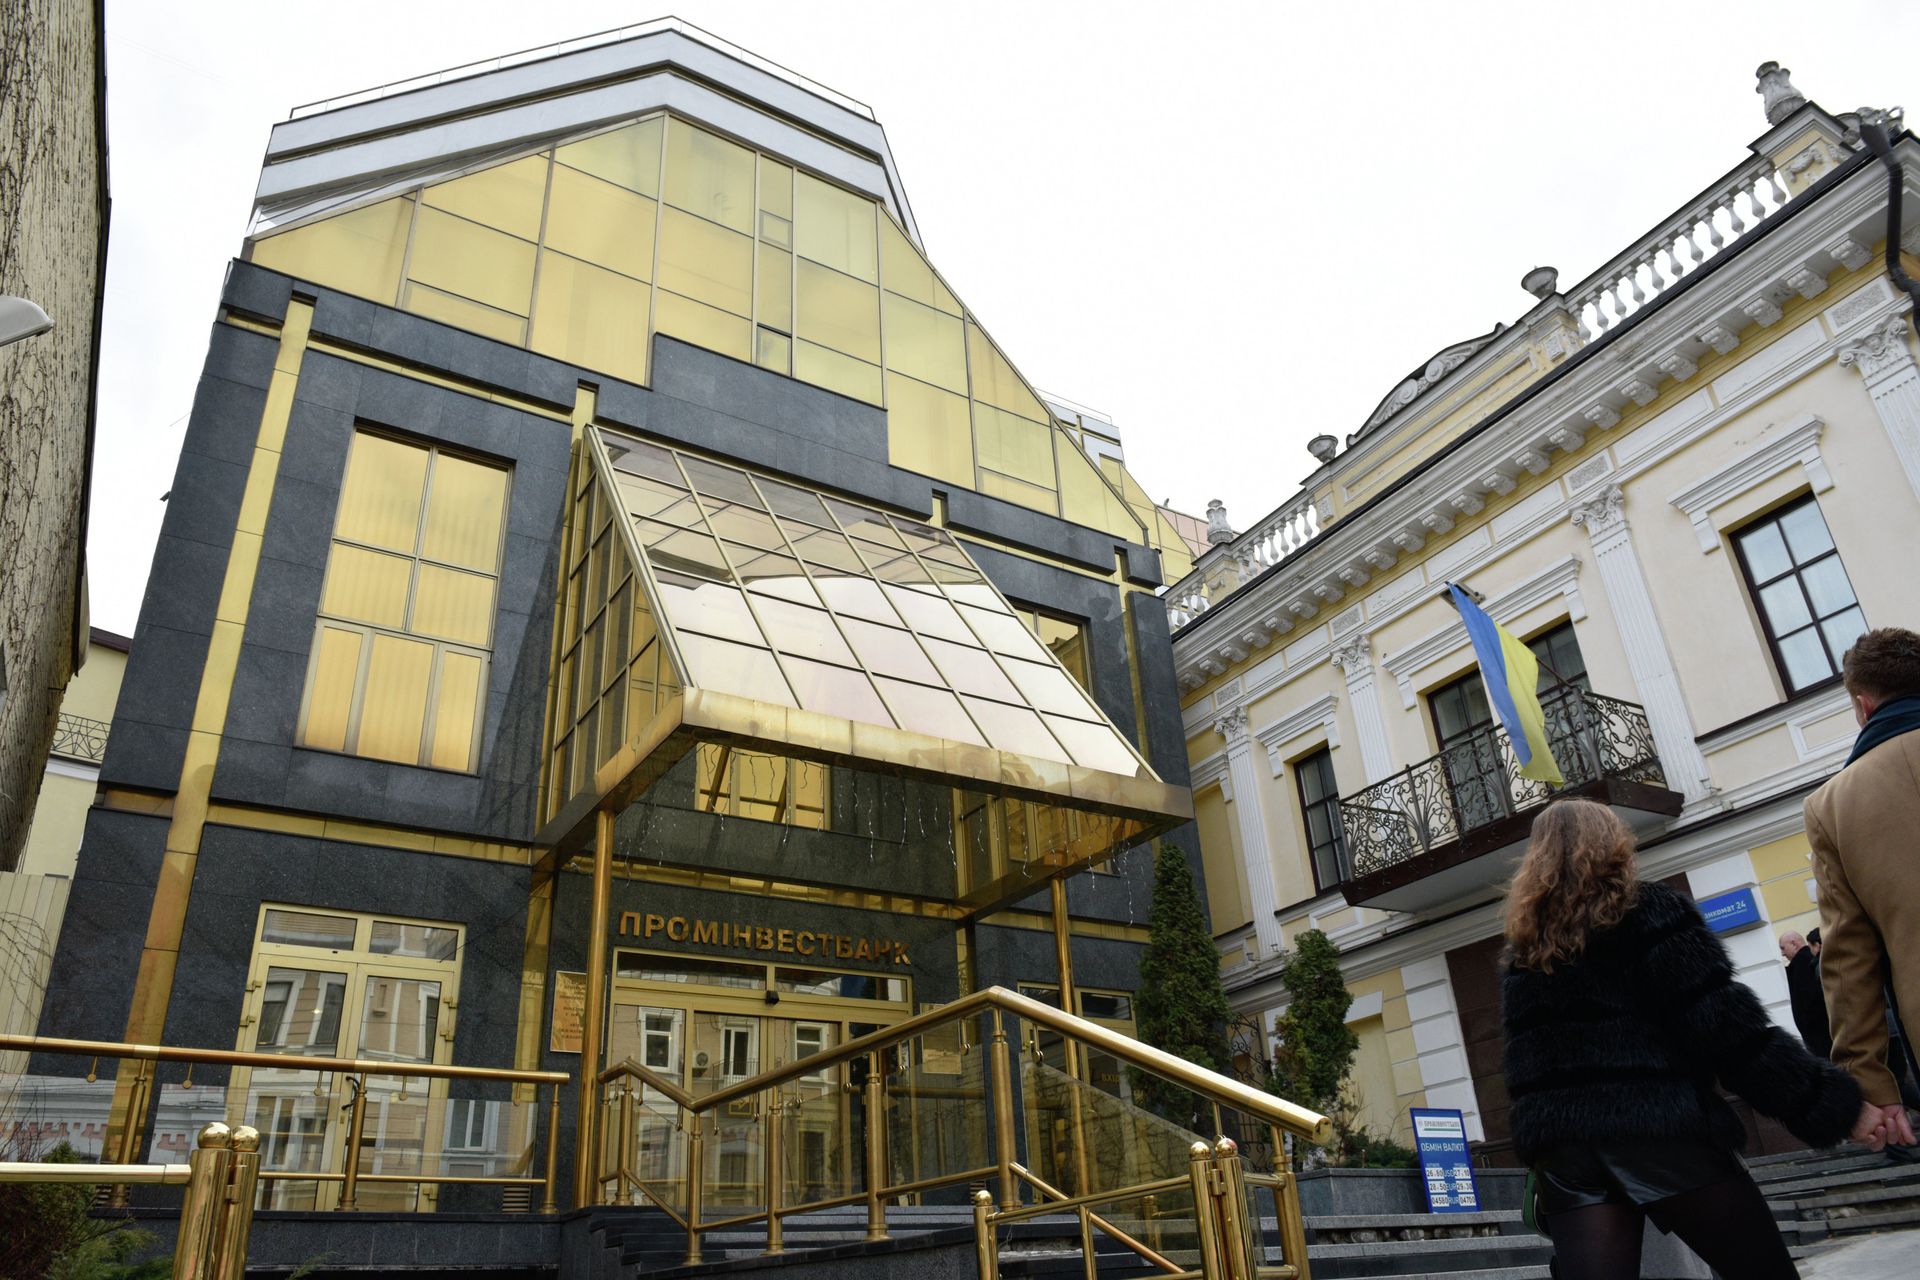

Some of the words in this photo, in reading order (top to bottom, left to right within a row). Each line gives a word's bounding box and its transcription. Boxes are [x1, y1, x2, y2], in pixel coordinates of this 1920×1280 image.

[1704, 905, 1734, 919] анкомат
[1735, 901, 1746, 910] 24
[619, 911, 911, 965] ПРОМІНВЕСТБАНК
[1420, 1142, 1442, 1151] ОБМІН
[1443, 1142, 1464, 1152] ВАЛЮТ
